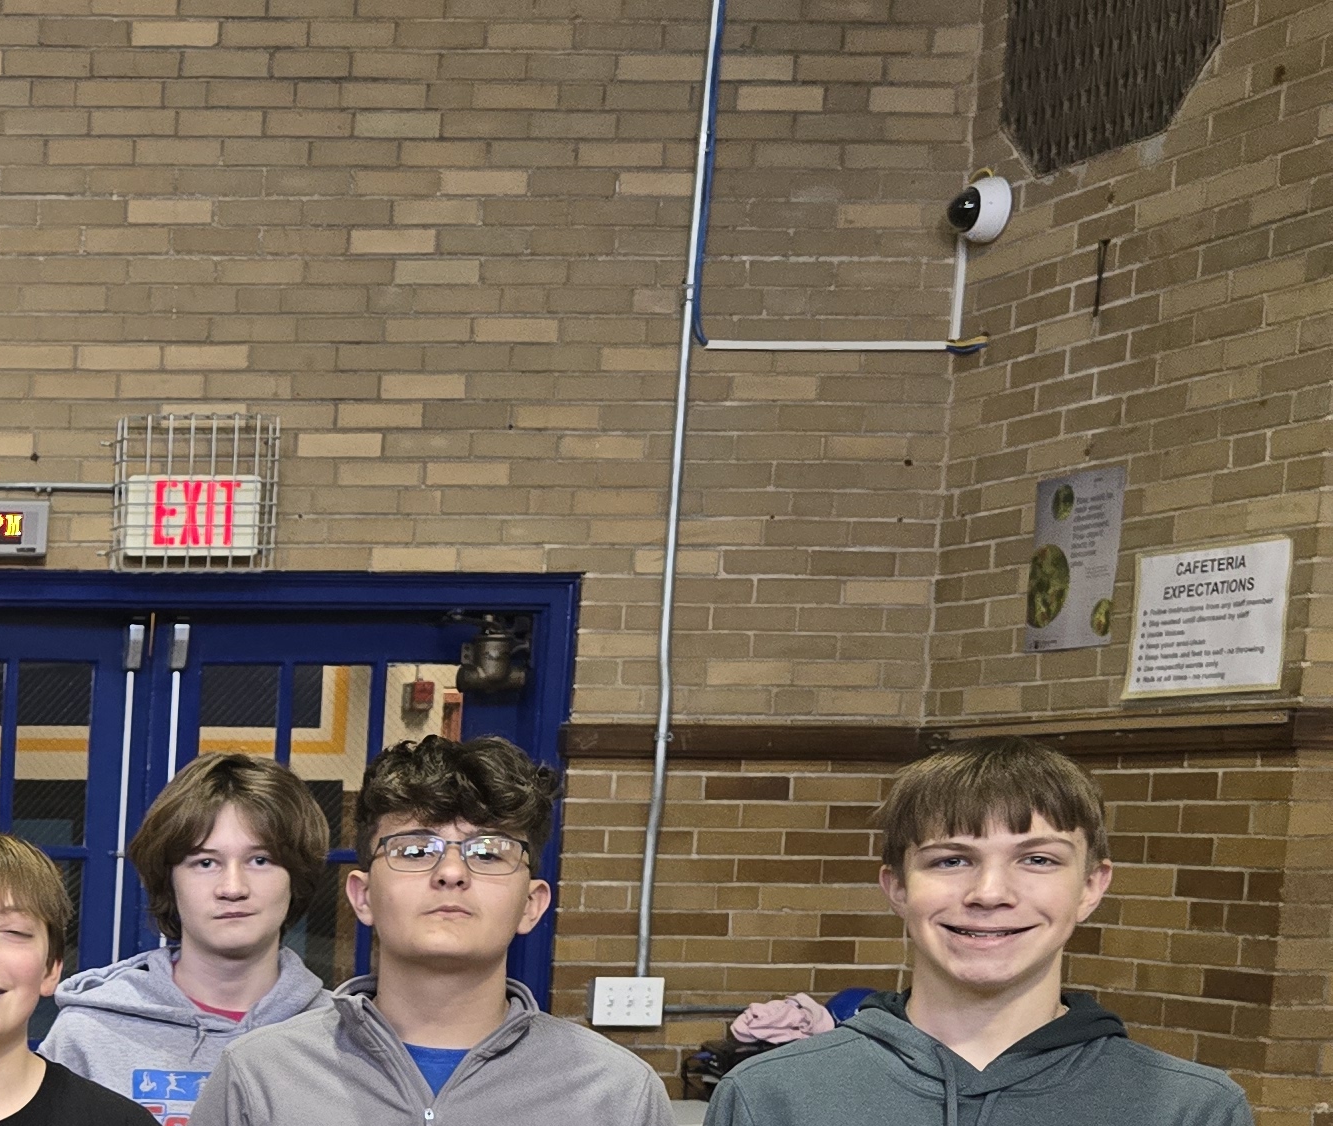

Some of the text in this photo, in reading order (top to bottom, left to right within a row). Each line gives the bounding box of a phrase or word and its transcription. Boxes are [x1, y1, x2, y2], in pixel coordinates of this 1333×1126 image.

[153, 480, 241, 546] EXIT
[1176, 555, 1247, 577] CAFETERIA
[1163, 577, 1255, 600] EXPECTATIONS
